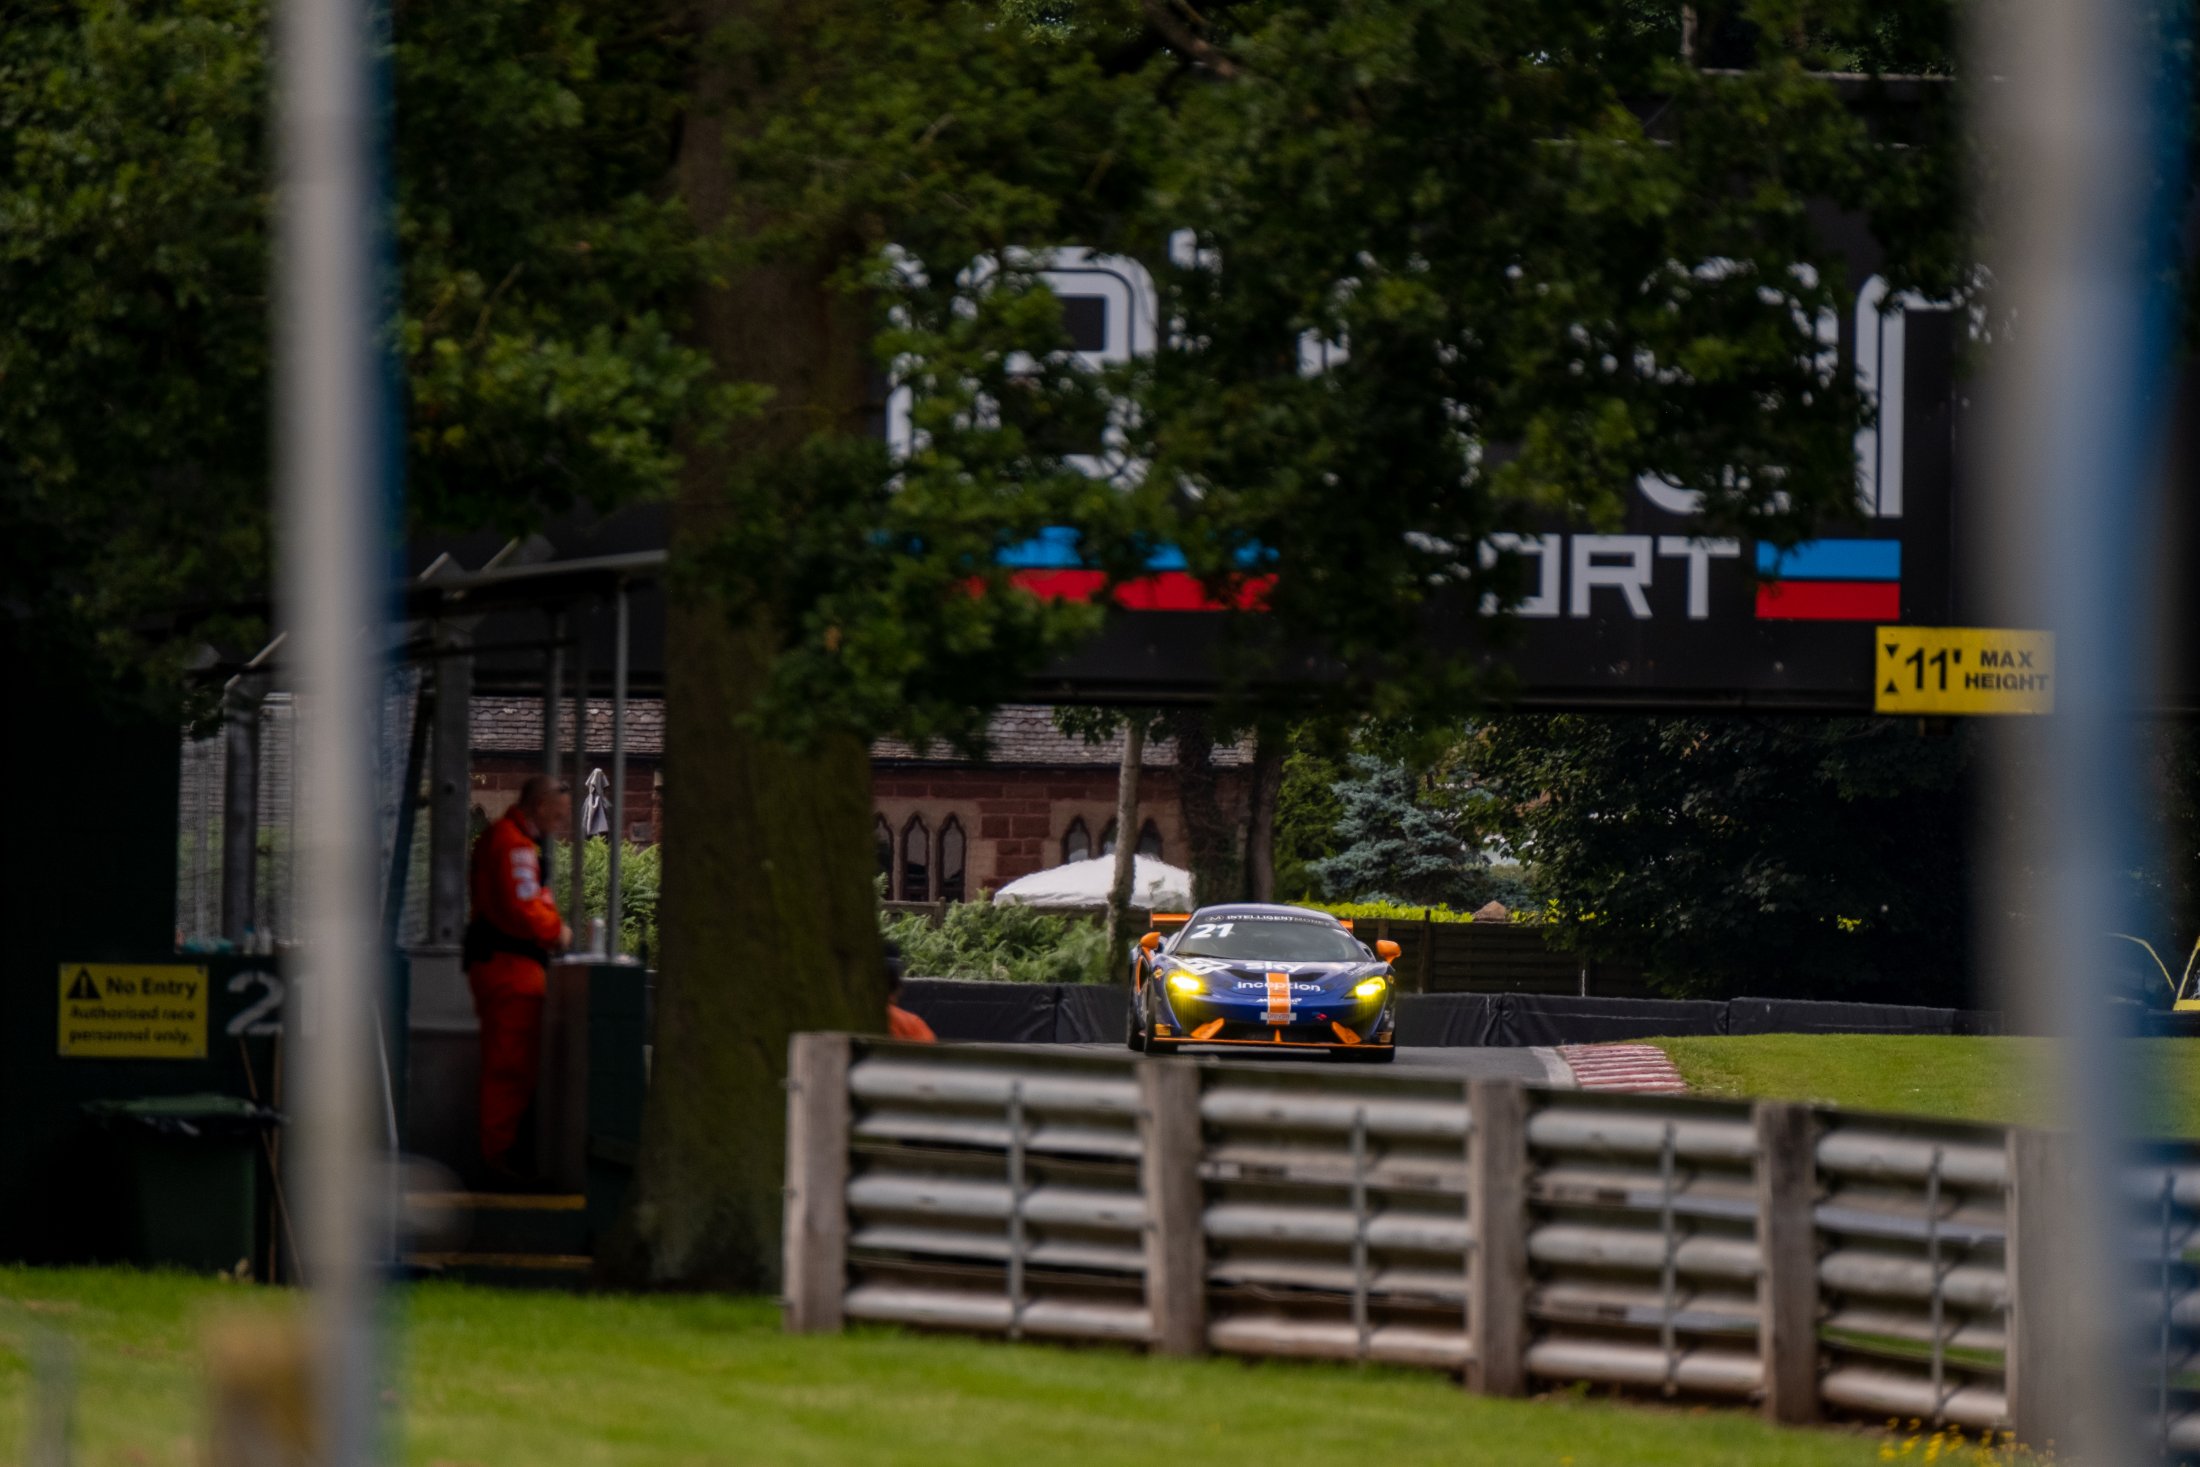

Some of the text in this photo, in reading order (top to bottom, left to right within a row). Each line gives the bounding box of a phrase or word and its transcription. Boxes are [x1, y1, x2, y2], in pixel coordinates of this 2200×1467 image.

[1980, 649, 2034, 668] MAX
[1965, 672, 2050, 690] HEIGHT
[1189, 923, 1235, 939] 21
[1245, 961, 1306, 973] sky
[105, 976, 198, 1000] No Entry
[1237, 980, 1321, 992] inception
[70, 1006, 196, 1020] Authorised race
[69, 1028, 150, 1043] personnel
